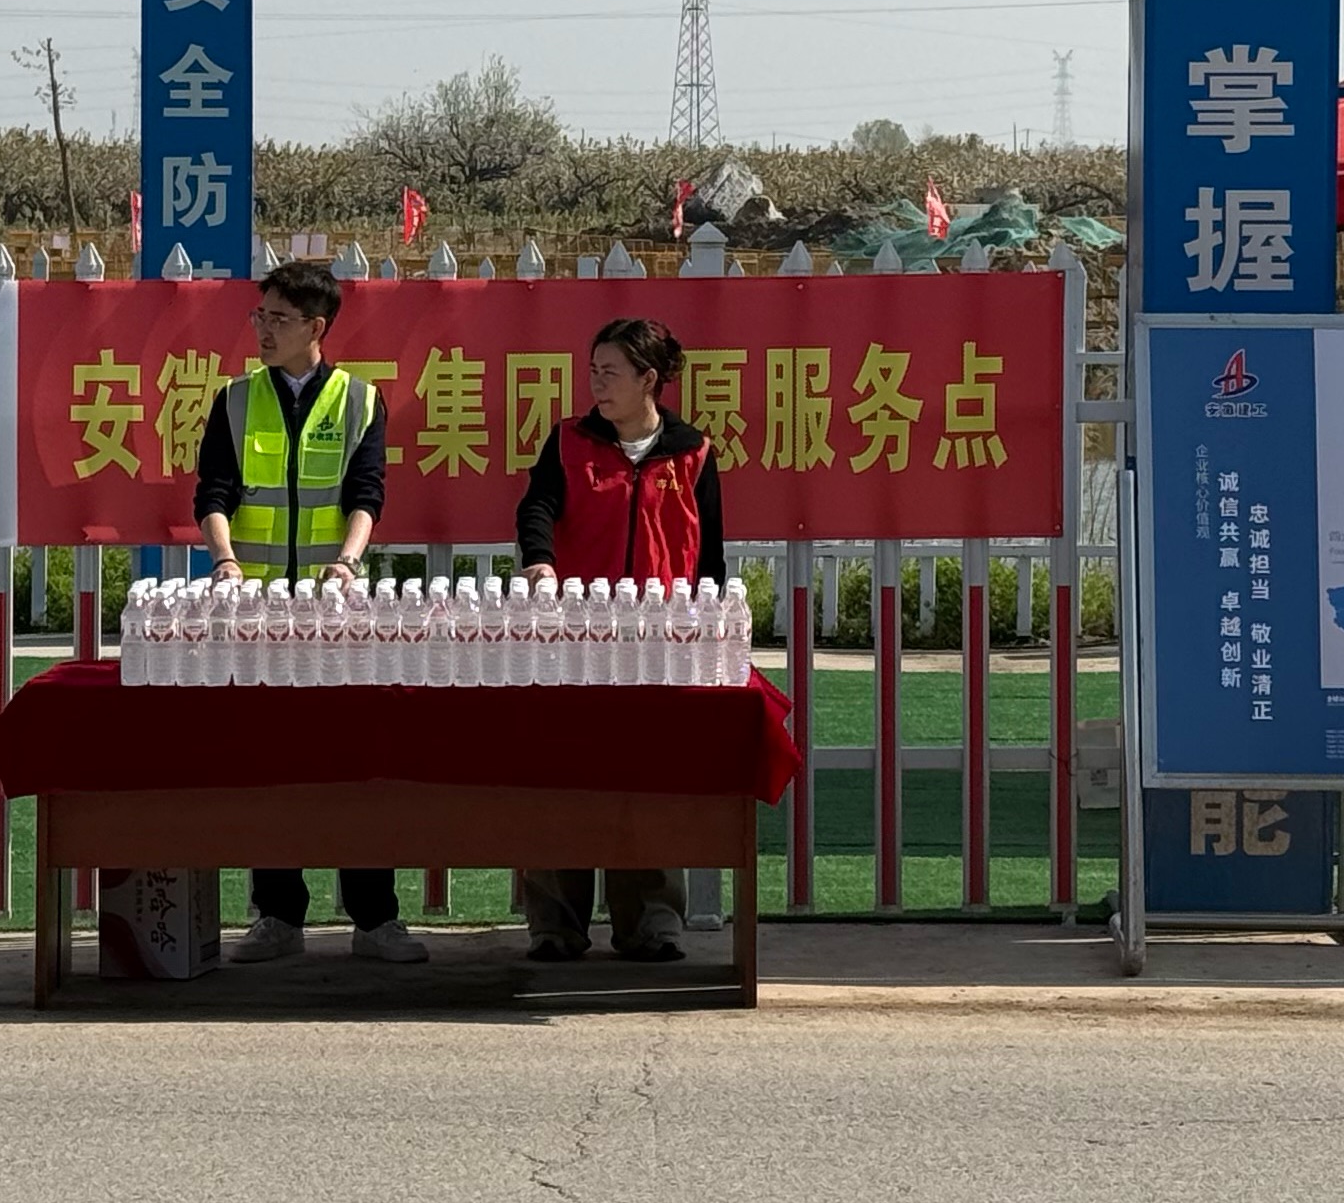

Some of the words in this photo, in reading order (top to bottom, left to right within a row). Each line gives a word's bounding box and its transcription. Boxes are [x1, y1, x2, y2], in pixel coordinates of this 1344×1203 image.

[70, 342, 1007, 479] 安徽工集团愿服务点
[1218, 471, 1240, 568] 诚信共赢
[1249, 503, 1271, 600] 忠诚担当
[1220, 591, 1242, 688] 卓越创新
[1250, 623, 1273, 720] 敬业清正
